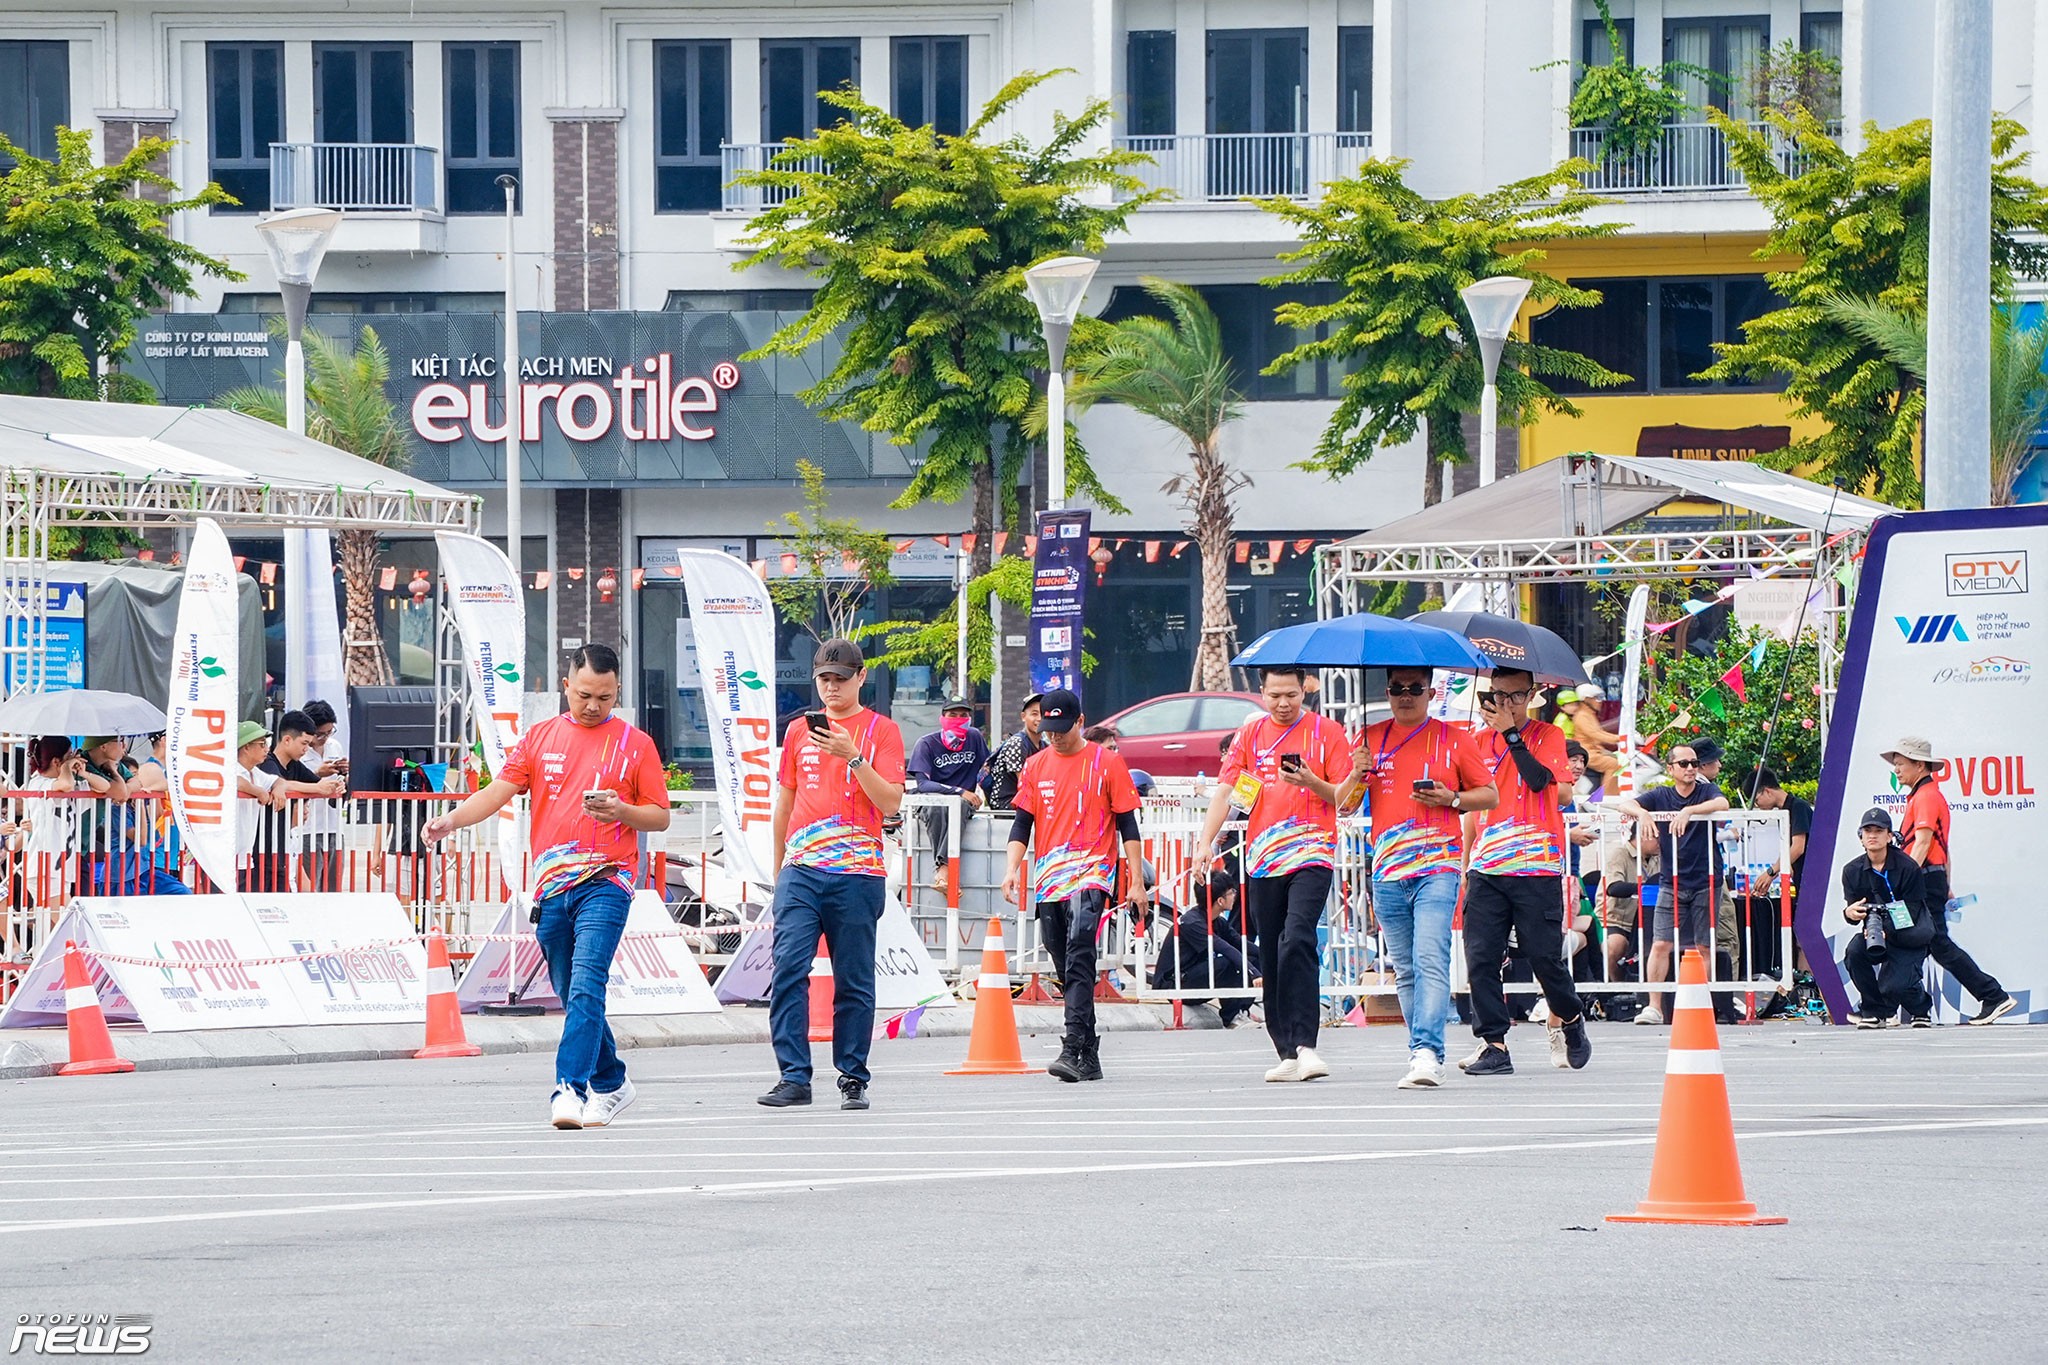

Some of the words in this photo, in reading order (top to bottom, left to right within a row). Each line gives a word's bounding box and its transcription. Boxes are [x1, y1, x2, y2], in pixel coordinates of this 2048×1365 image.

[145, 330, 172, 343] CÔNG
[174, 332, 189, 343] TY
[191, 332, 205, 343] CP
[207, 332, 231, 343] KINH
[233, 332, 268, 343] DOANH
[191, 344, 210, 357] LÁT
[213, 346, 269, 357] VIGLACERA
[411, 353, 450, 380] KIỆT
[459, 352, 496, 377] TÁC
[570, 356, 613, 377] MEN
[1953, 560, 2021, 577] OTV
[1953, 576, 2023, 592] MEDIA
[1994, 631, 2012, 639] NAM
[2010, 621, 2030, 630] THAO
[178, 652, 191, 680] PVOIL
[187, 634, 198, 702] PETROVIETNAM
[479, 641, 496, 706] PETROVIETNAM
[714, 668, 727, 695] PVOIL
[723, 650, 740, 712] PETROVIETNAM
[183, 708, 226, 834] PVOIL
[736, 717, 772, 832] PVOIL
[1932, 755, 2034, 797] PVOIL
[1146, 798, 1181, 807] THÔNG
[1873, 794, 1907, 805] PETROVIE
[1972, 802, 1984, 810] xa
